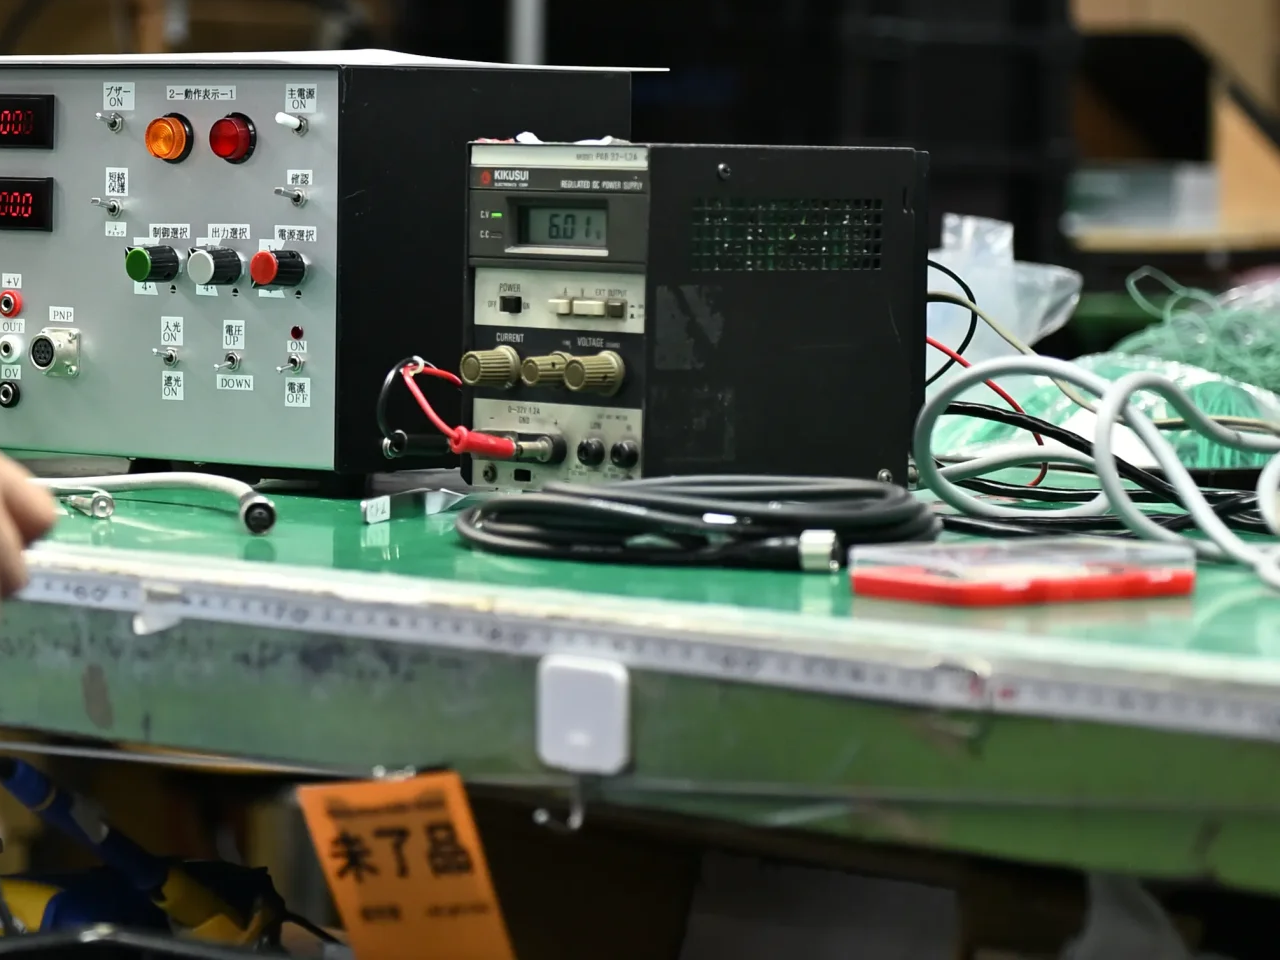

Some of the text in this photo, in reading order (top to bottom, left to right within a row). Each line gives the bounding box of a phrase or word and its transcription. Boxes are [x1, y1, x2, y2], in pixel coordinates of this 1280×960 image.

[105, 86, 131, 98] ブザー
[288, 88, 315, 99] 主電源
[109, 97, 123, 107] ON
[292, 100, 307, 109] ON
[291, 173, 309, 185] 確認
[494, 170, 529, 180] KIKUSUI
[561, 180, 590, 189] REGULATED
[602, 181, 621, 190] POWER
[623, 182, 643, 190] SUPPLY
[153, 227, 188, 238] 制御選択
[211, 227, 247, 239] 出力選択
[278, 229, 314, 240] 電源選択
[6, 277, 19, 287] +V
[499, 283, 520, 292] POWER
[53, 310, 72, 320] PNP
[2, 321, 23, 332] OUT
[163, 321, 181, 333] 入光
[225, 324, 243, 336] 電圧
[163, 332, 176, 342] ON
[225, 335, 239, 346] UP
[496, 332, 525, 343] CURRENT
[577, 337, 604, 348] VOLTAGE
[290, 341, 305, 351] ON
[164, 375, 182, 387] 遮光
[221, 378, 251, 389] DOWN
[163, 386, 178, 396] ON
[287, 381, 306, 393] 電源
[286, 393, 308, 403] OFF
